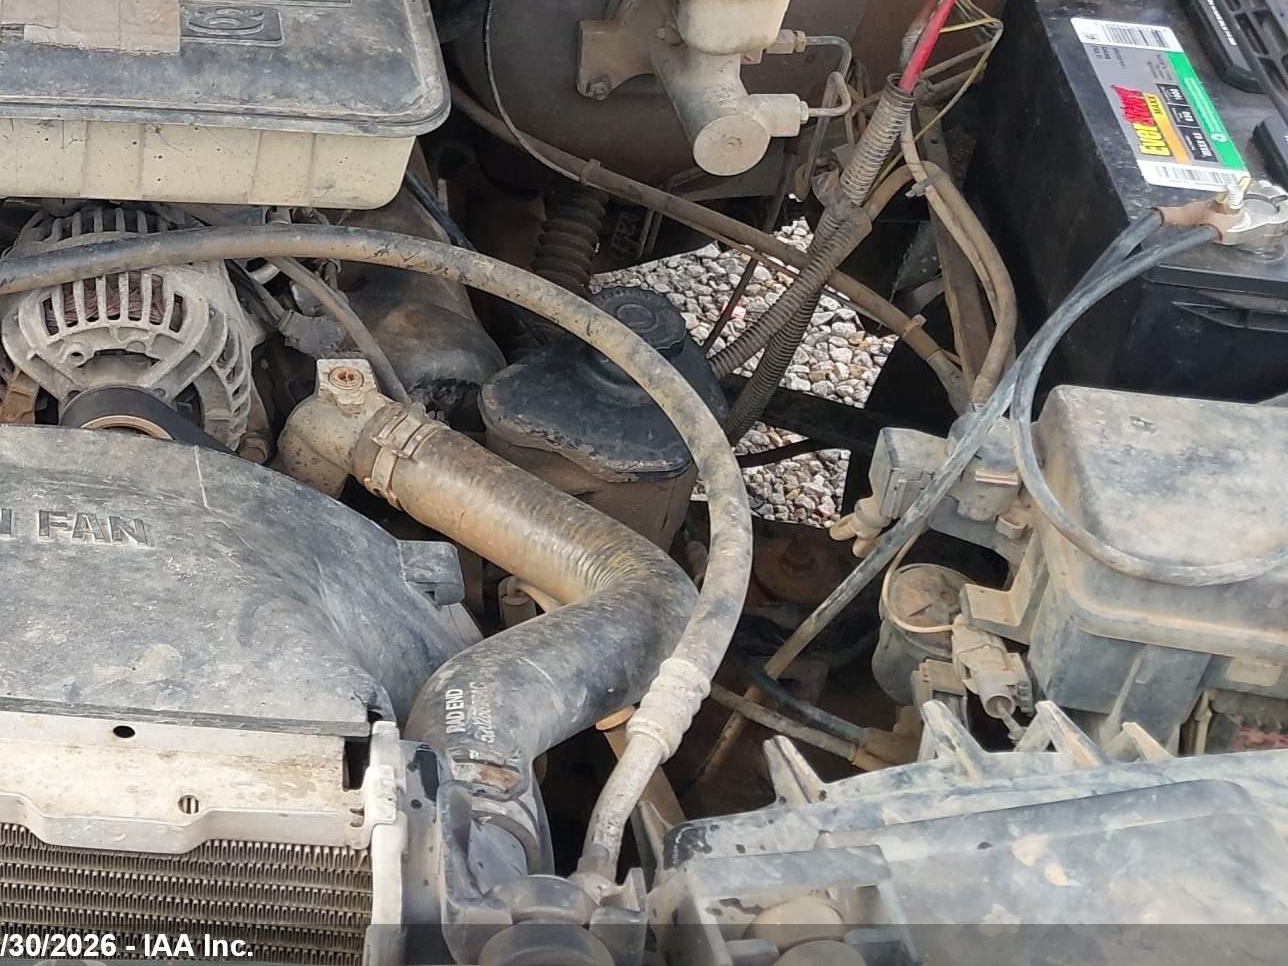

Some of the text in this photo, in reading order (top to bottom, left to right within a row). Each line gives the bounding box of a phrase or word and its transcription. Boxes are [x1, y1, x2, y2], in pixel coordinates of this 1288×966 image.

[1146, 95, 1164, 115] MAXX
[37, 508, 154, 550] FAN
[445, 688, 467, 734] RAD END
